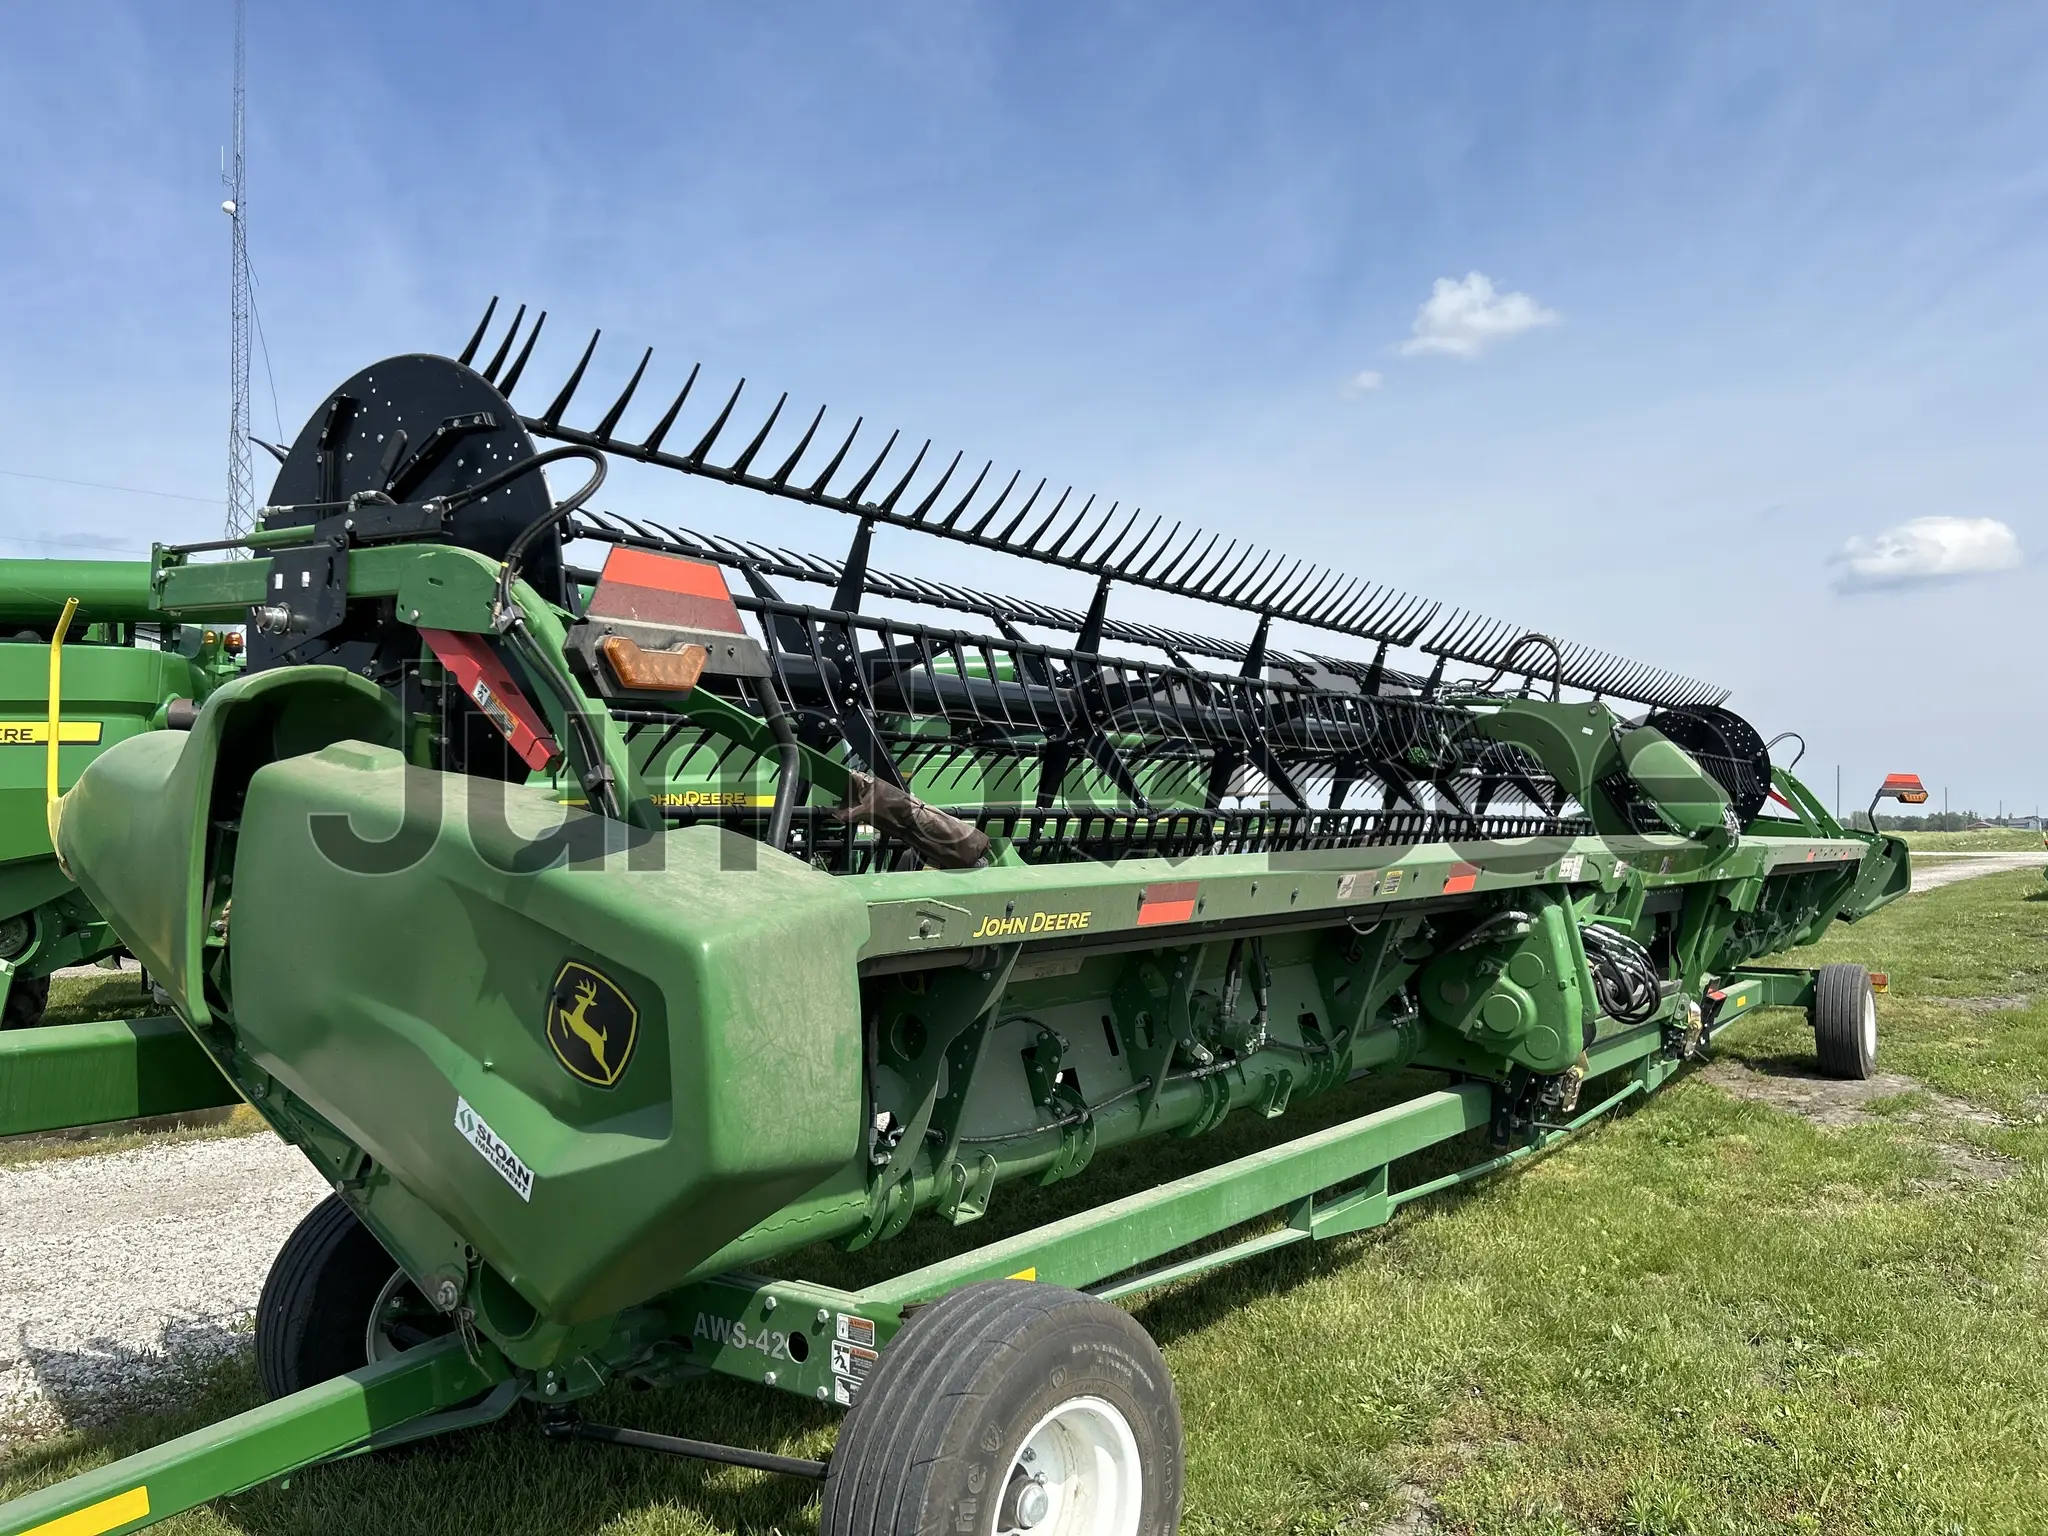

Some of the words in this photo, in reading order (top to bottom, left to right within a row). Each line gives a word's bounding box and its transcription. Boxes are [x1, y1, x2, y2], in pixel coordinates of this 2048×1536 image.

[0, 728, 34, 741] RE
[685, 790, 746, 805] DEERE
[972, 915, 1029, 938] JOHN
[1029, 911, 1092, 934] DEERE
[474, 1136, 528, 1194] IMPLEMENT
[476, 1123, 530, 1187] SLOAN
[693, 1311, 785, 1360] AWS-42
